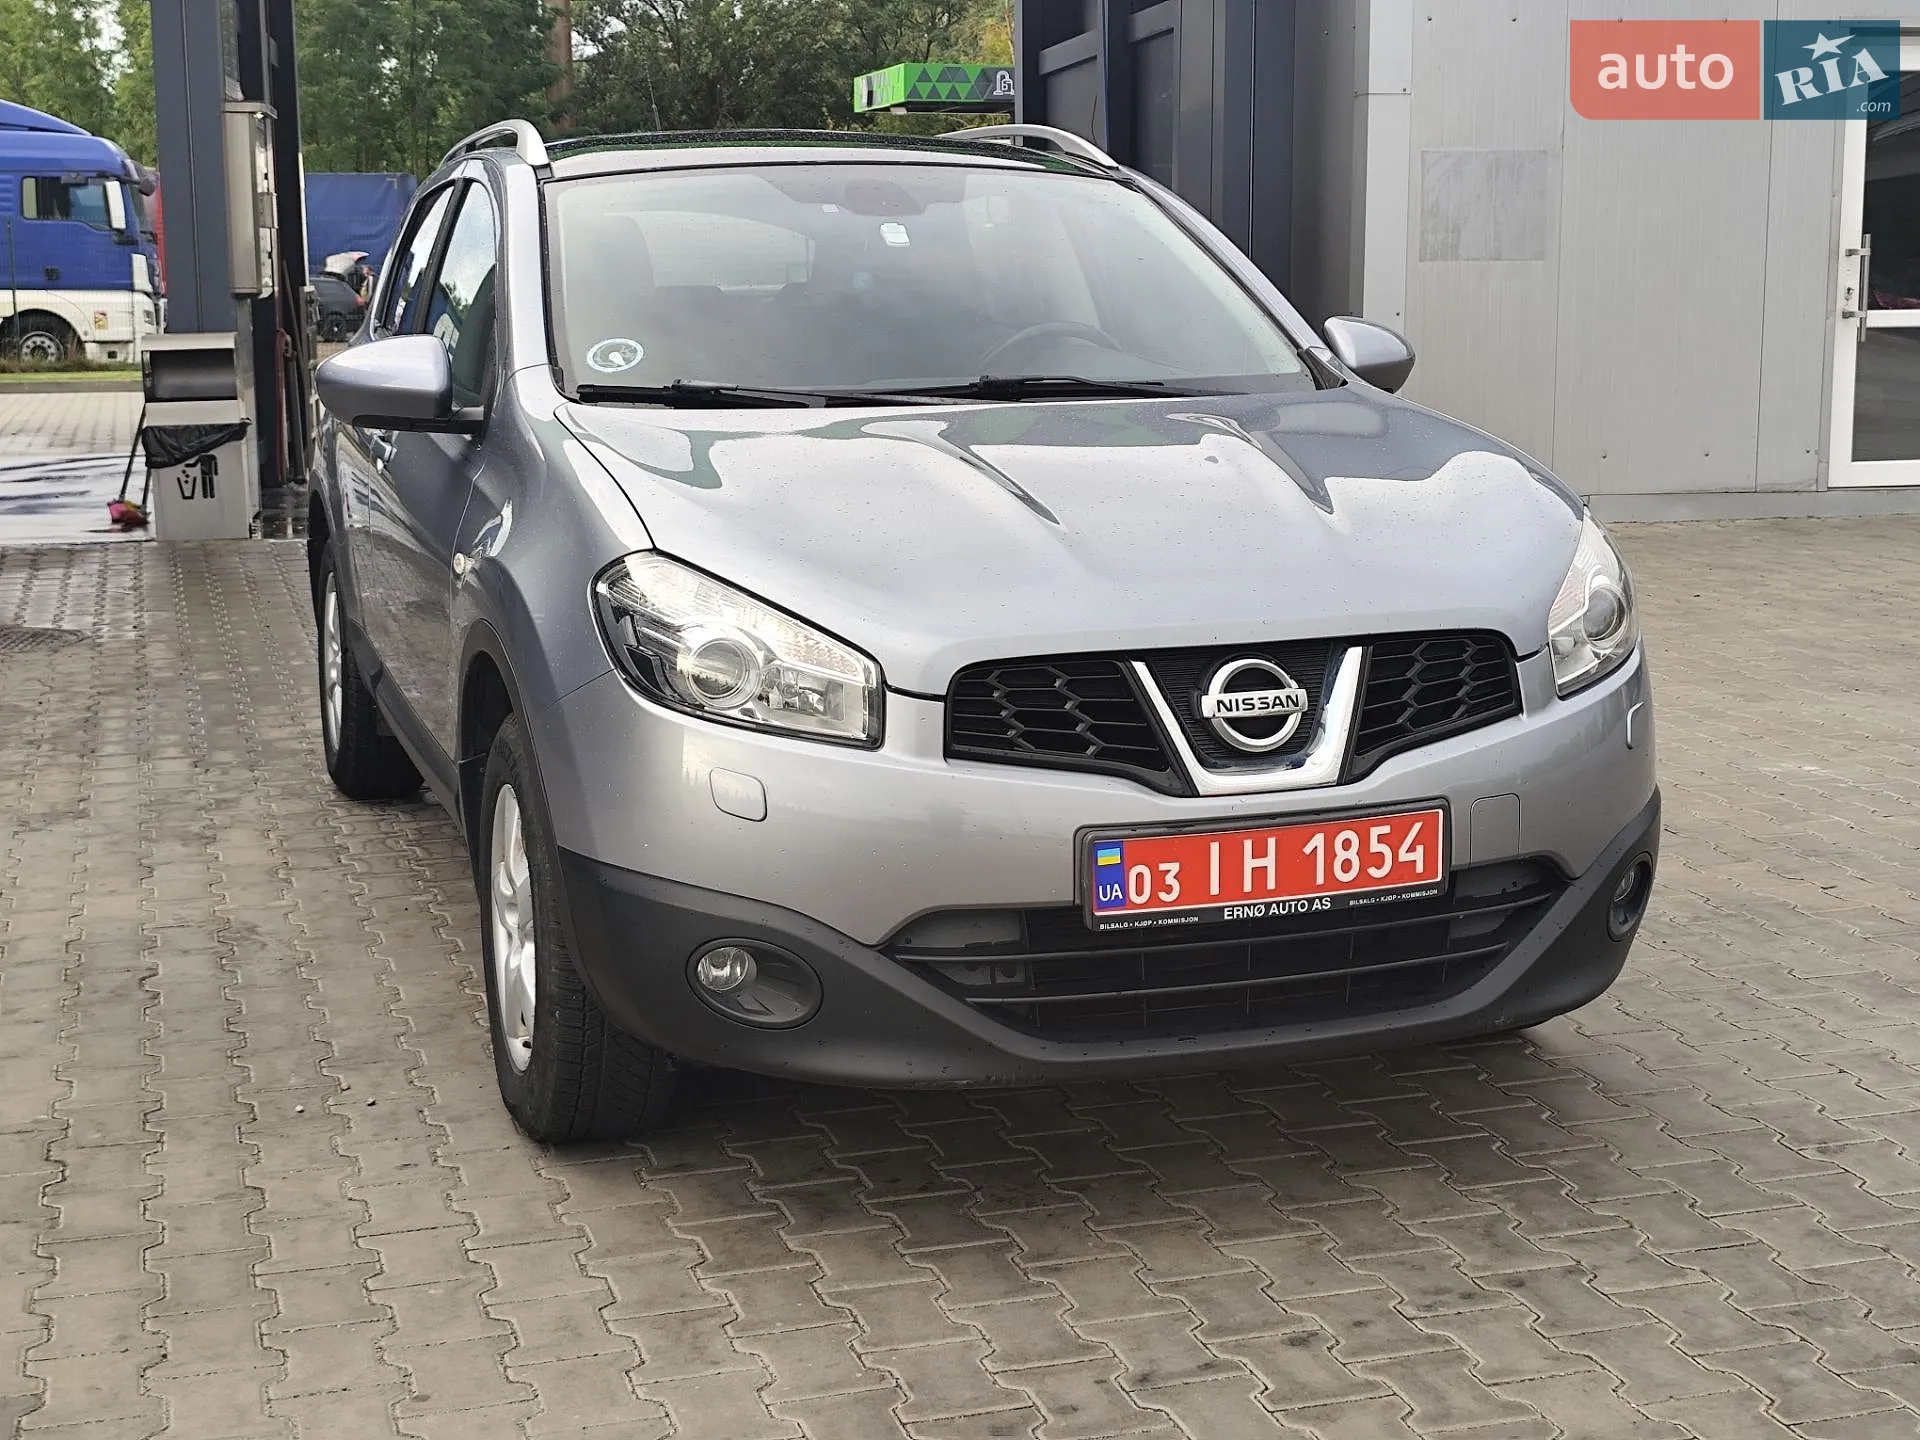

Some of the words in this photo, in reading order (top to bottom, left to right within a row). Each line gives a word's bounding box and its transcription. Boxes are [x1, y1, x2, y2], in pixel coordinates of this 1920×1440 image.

[1216, 694, 1300, 713] NISSAN
[1098, 883, 1123, 902] UA
[1128, 862, 1181, 905] 03
[1209, 836, 1276, 896] IH
[1302, 821, 1425, 886] 1854
[1349, 897, 1375, 906] BILSALG
[1380, 894, 1397, 902] KJØP
[1401, 888, 1438, 900] KOMMISJON
[1223, 904, 1265, 920] ERNØ
[1268, 900, 1309, 916] AUTO
[1311, 897, 1331, 911] AS
[1099, 922, 1129, 930] BILSALG
[1134, 919, 1152, 927] KJØP
[1158, 916, 1199, 925] KOMMISJON
